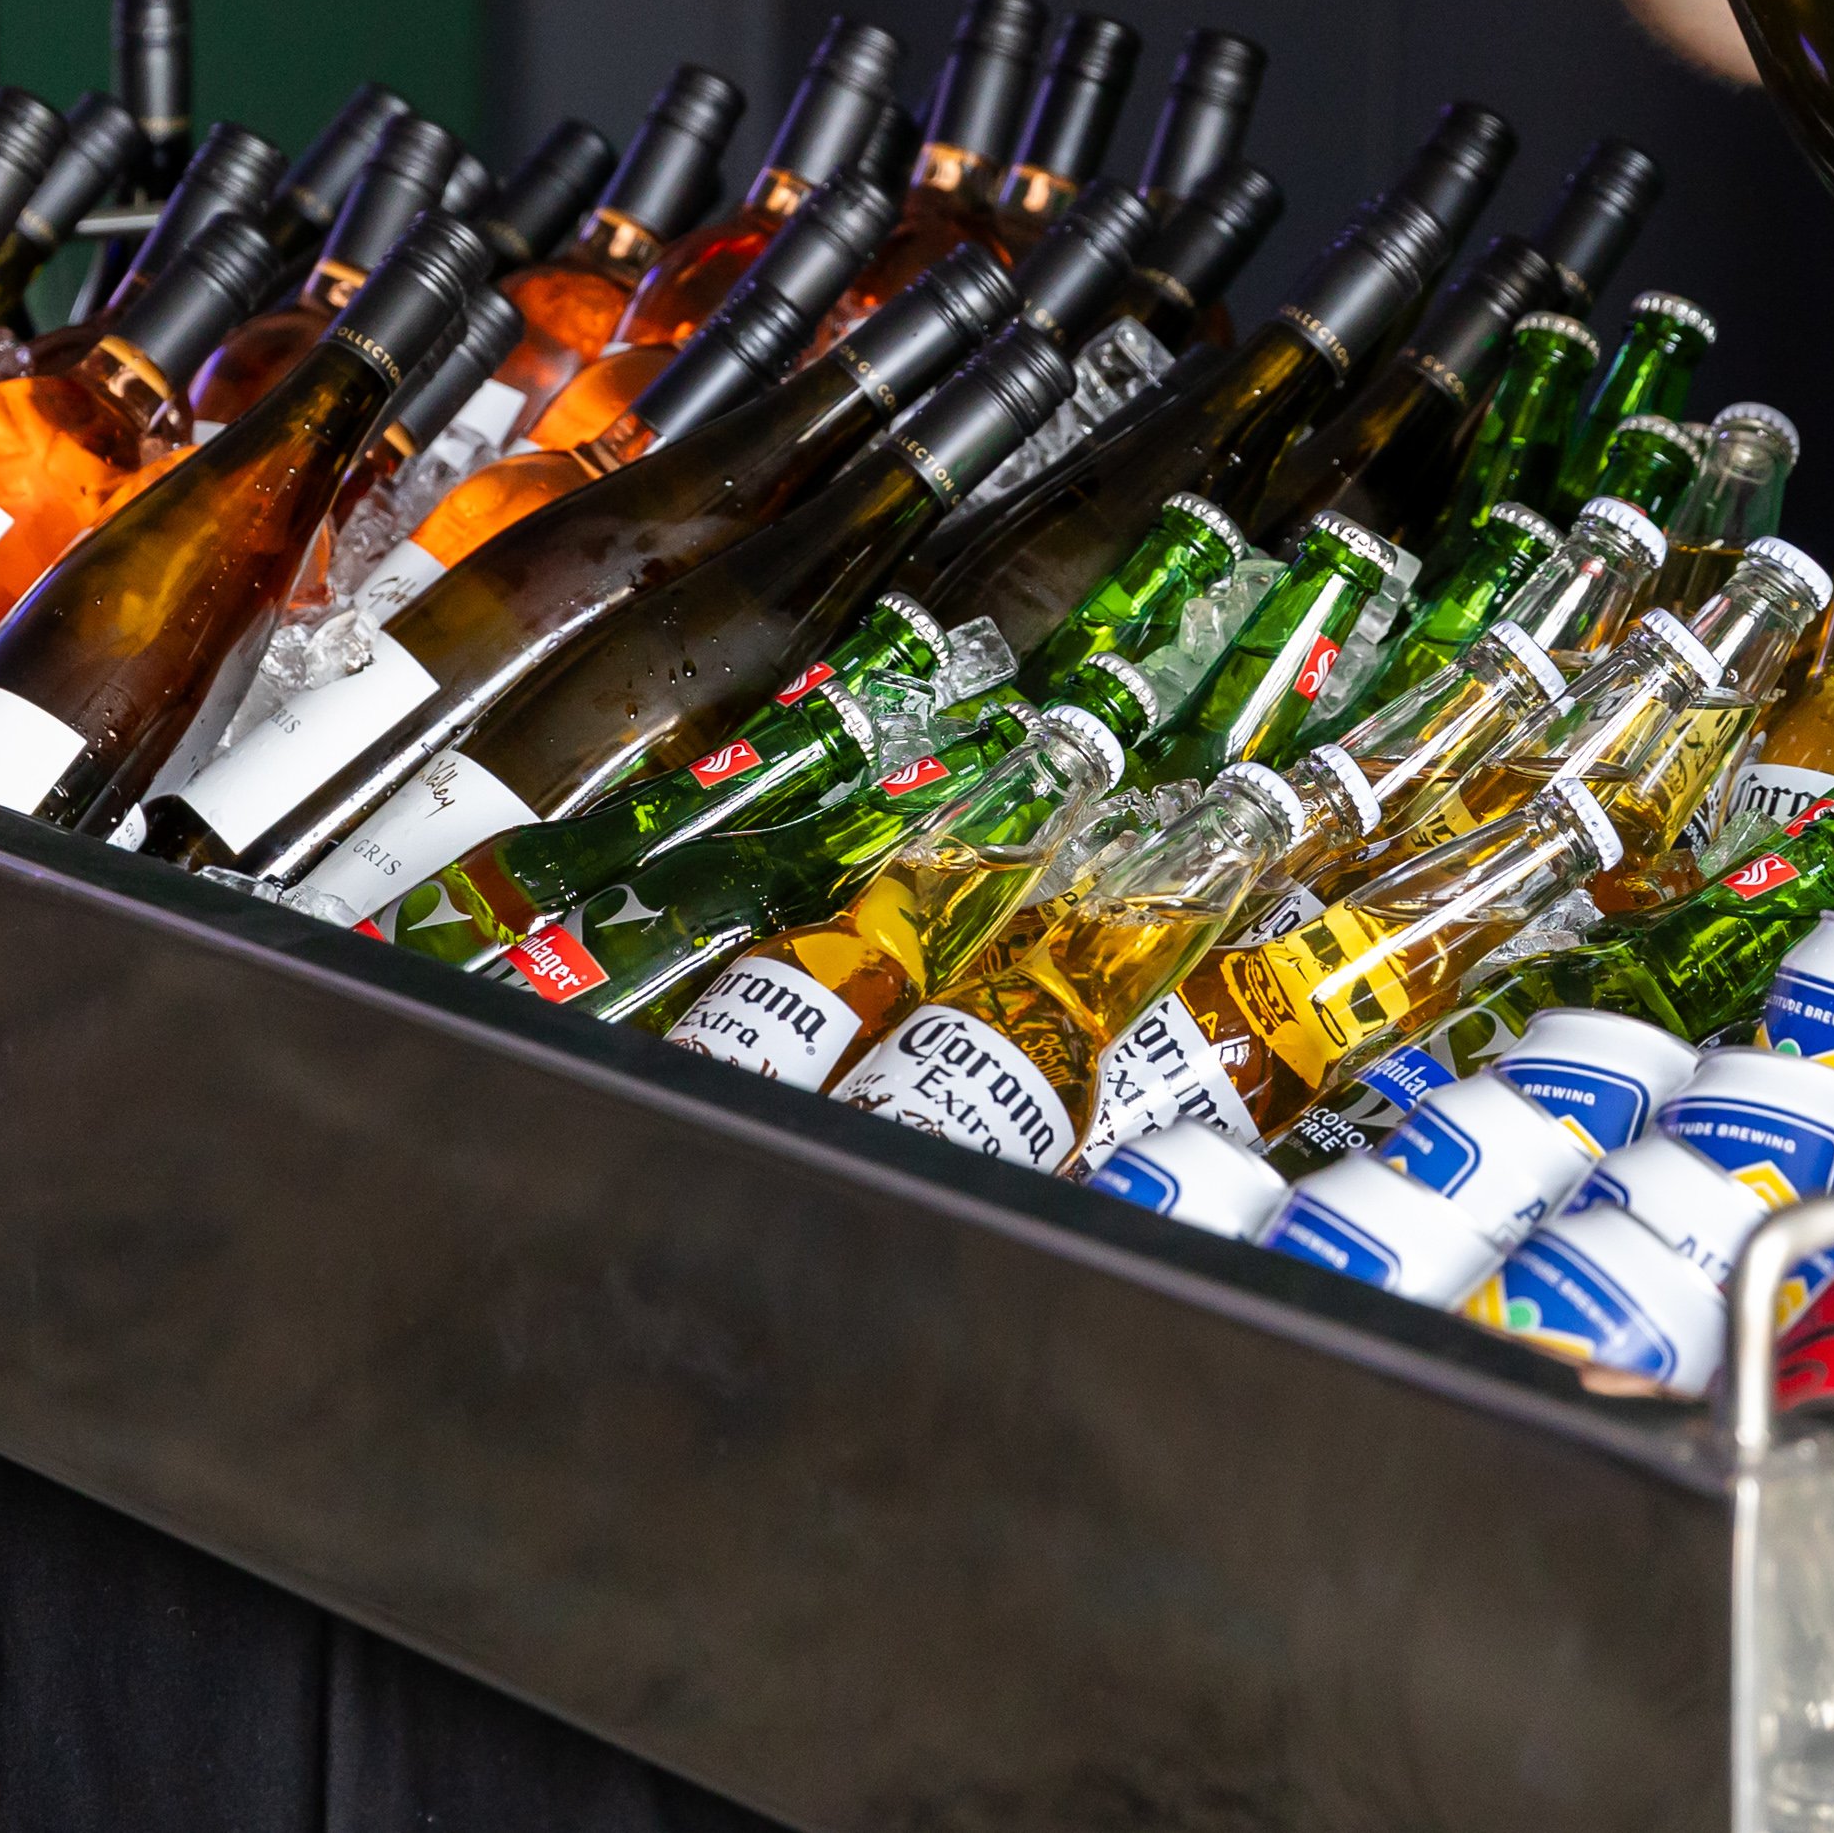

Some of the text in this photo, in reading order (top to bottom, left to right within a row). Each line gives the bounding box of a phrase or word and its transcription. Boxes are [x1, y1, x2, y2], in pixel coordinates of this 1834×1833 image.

[271, 707, 302, 735] RIS
[424, 758, 460, 820] Valley
[352, 837, 403, 877] GRIS
[705, 971, 828, 1043] orona
[897, 1014, 1055, 1165] Corona
[911, 1064, 1002, 1159] Extra
[1522, 1082, 1597, 1107] BREWING
[1716, 1120, 1797, 1155] BREWING
